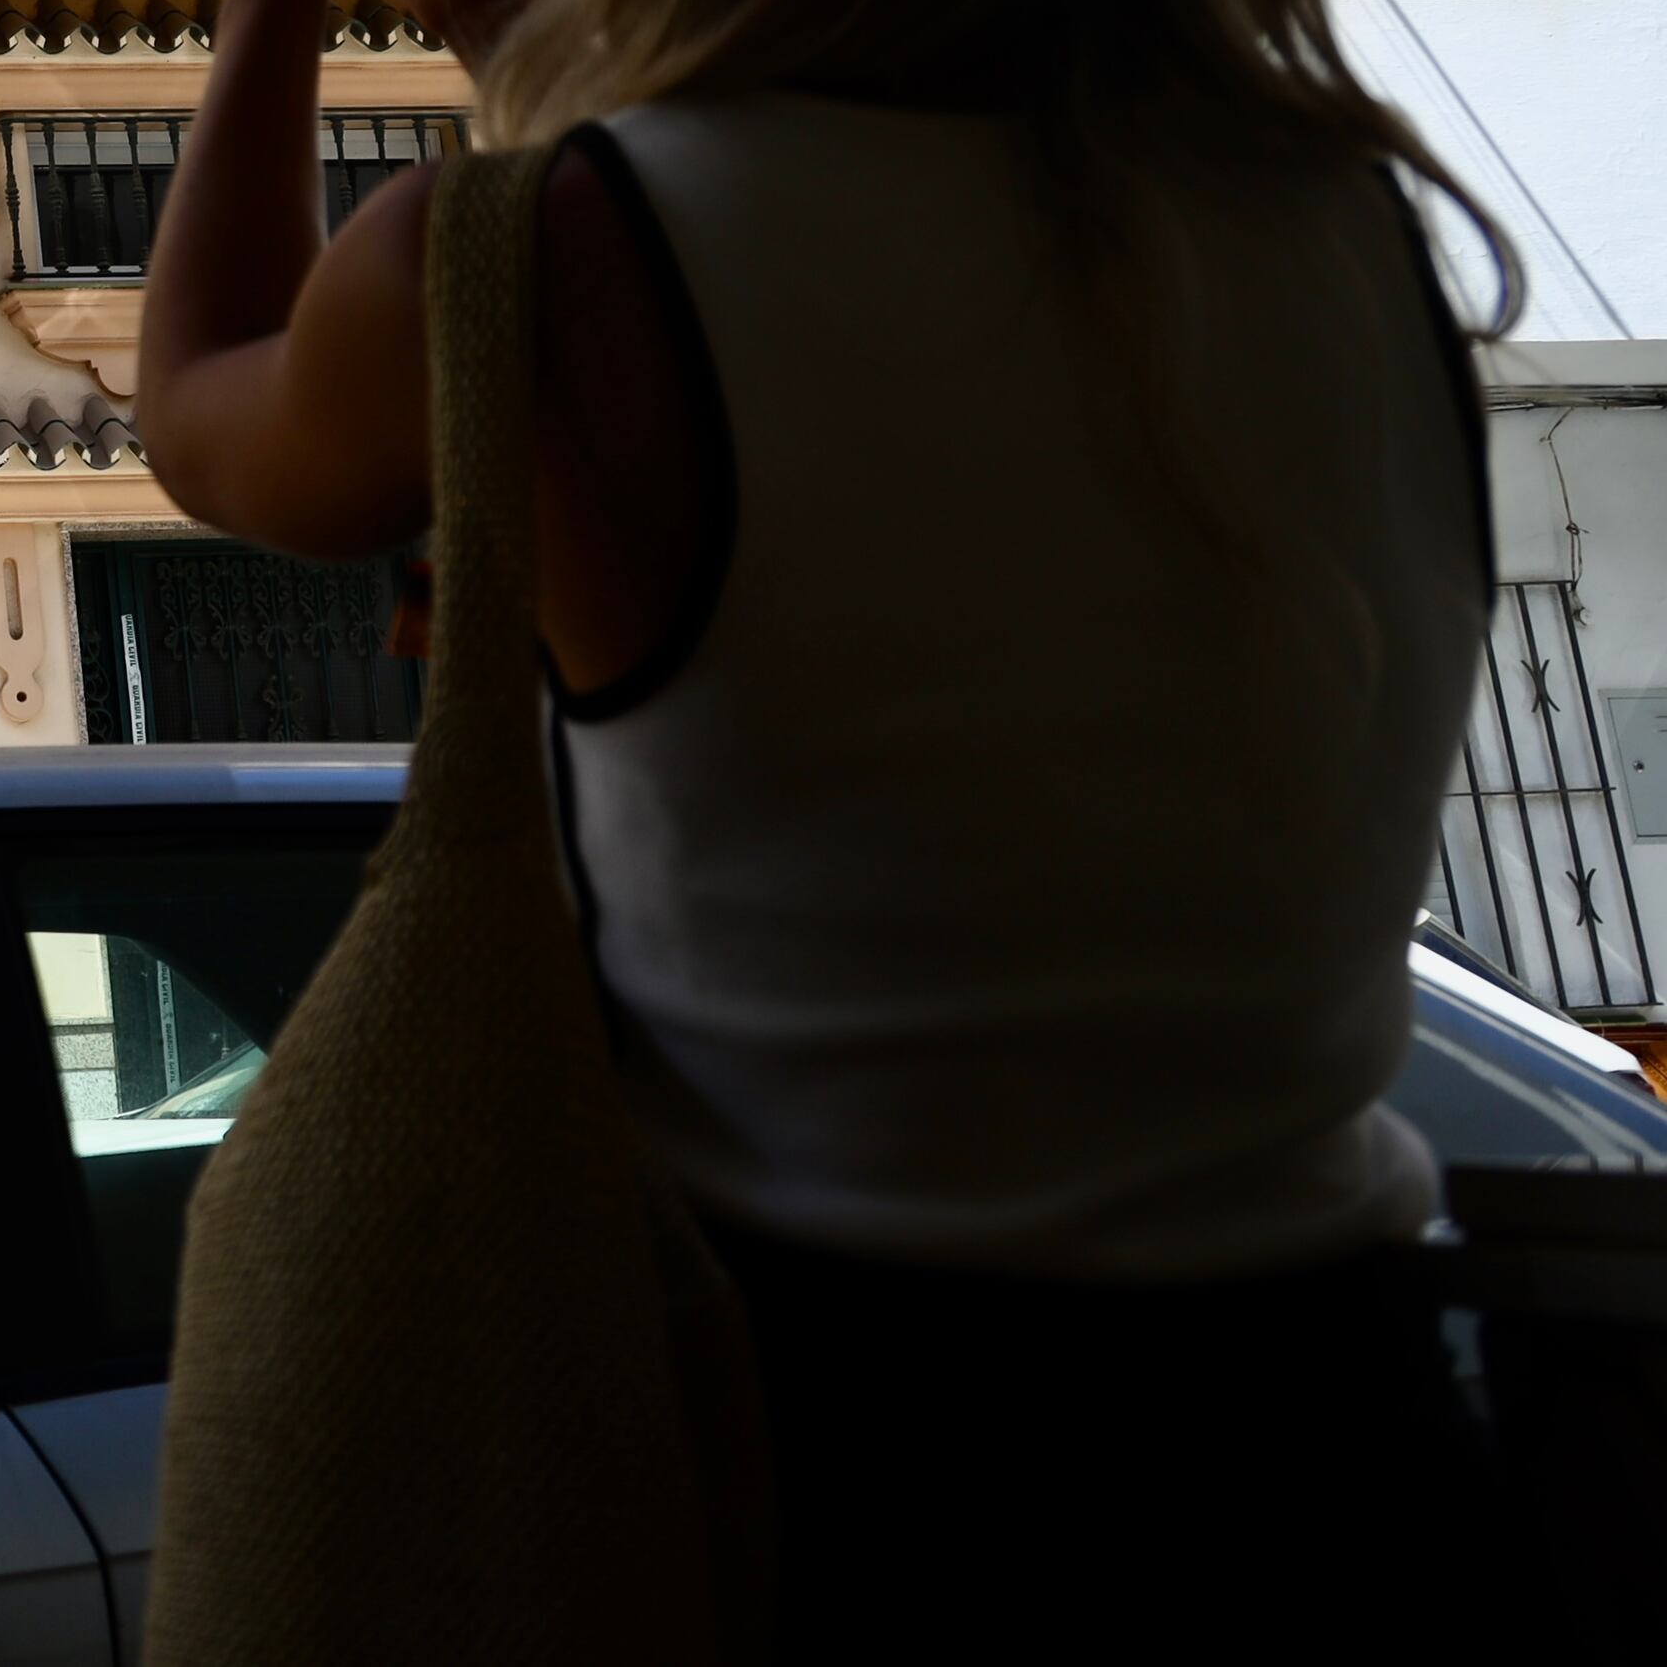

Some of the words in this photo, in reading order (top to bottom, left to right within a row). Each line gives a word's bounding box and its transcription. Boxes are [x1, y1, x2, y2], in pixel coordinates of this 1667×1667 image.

[126, 614, 135, 645] UARDIA
[128, 646, 137, 667] CIVIL
[135, 721, 144, 742] CIVIL
